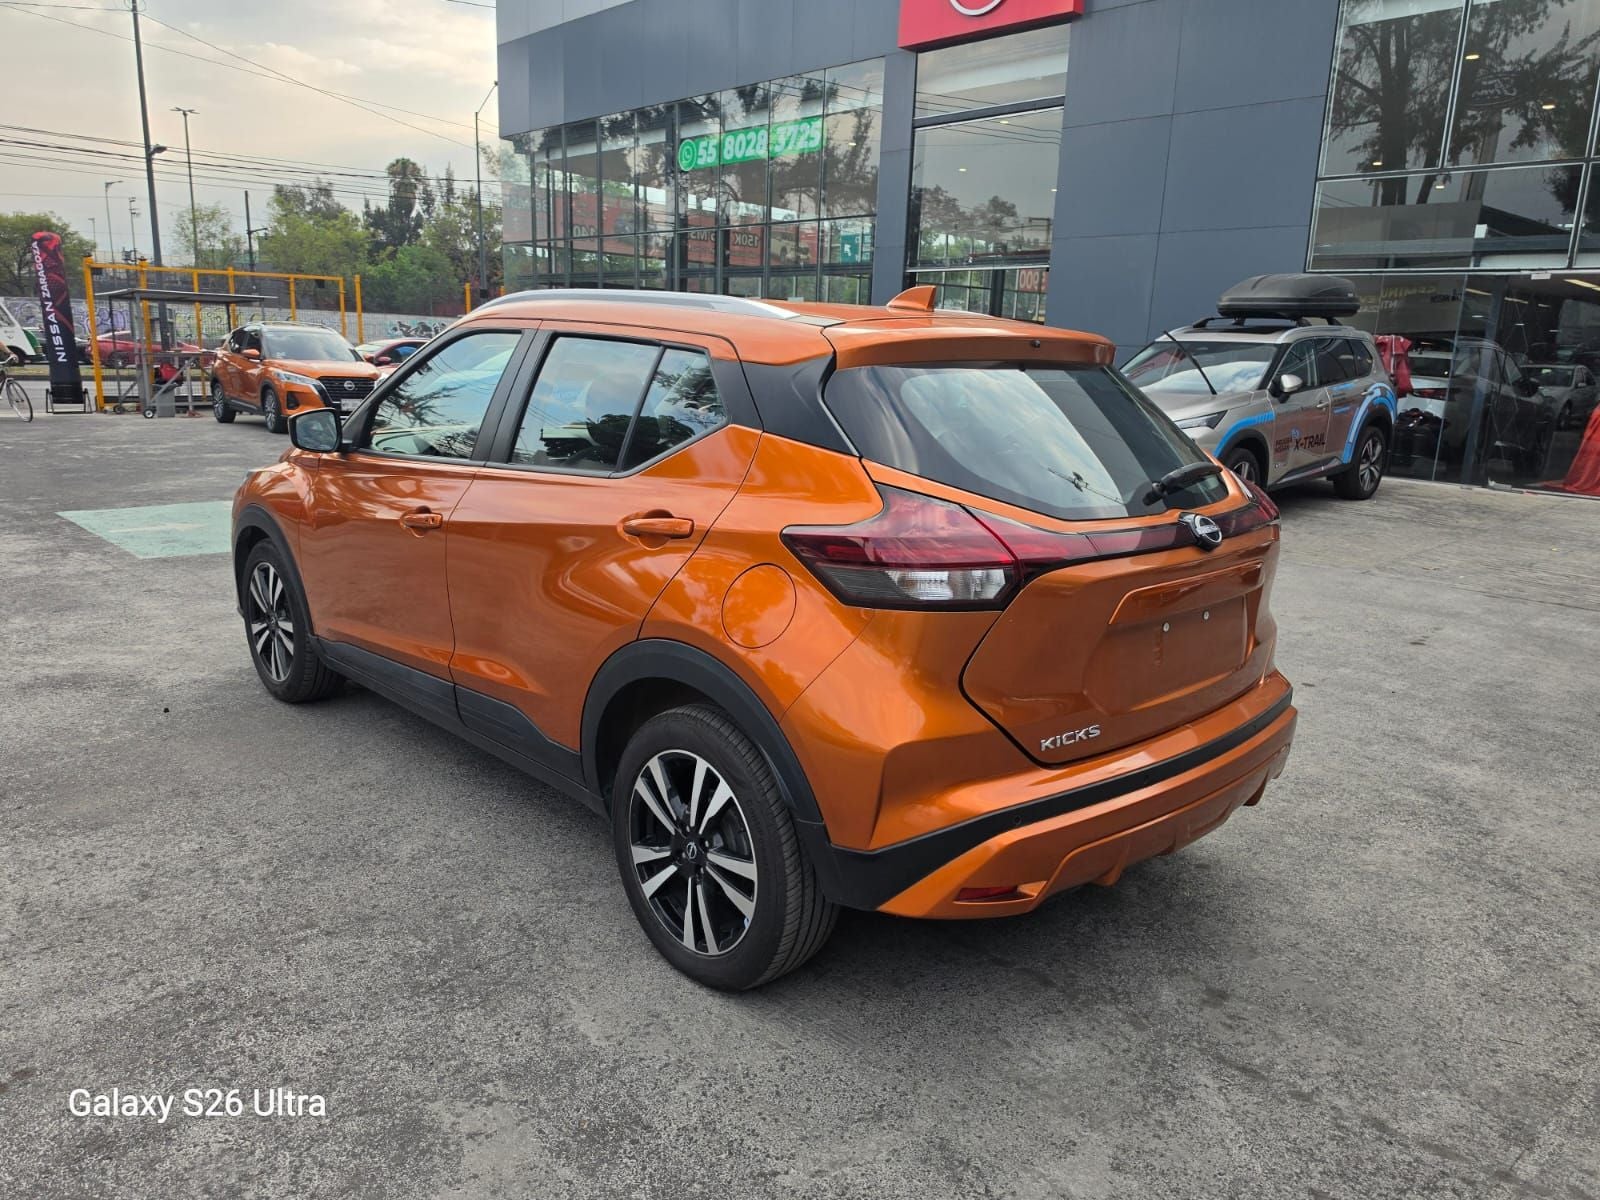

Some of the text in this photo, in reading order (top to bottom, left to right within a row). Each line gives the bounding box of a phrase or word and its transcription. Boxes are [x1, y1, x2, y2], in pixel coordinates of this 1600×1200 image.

[697, 122, 822, 164] 55 8028 3725
[32, 241, 67, 362] NISSAN ZARAGOZA
[1294, 432, 1325, 451] X-TRAIL
[1040, 724, 1101, 752] KICKS
